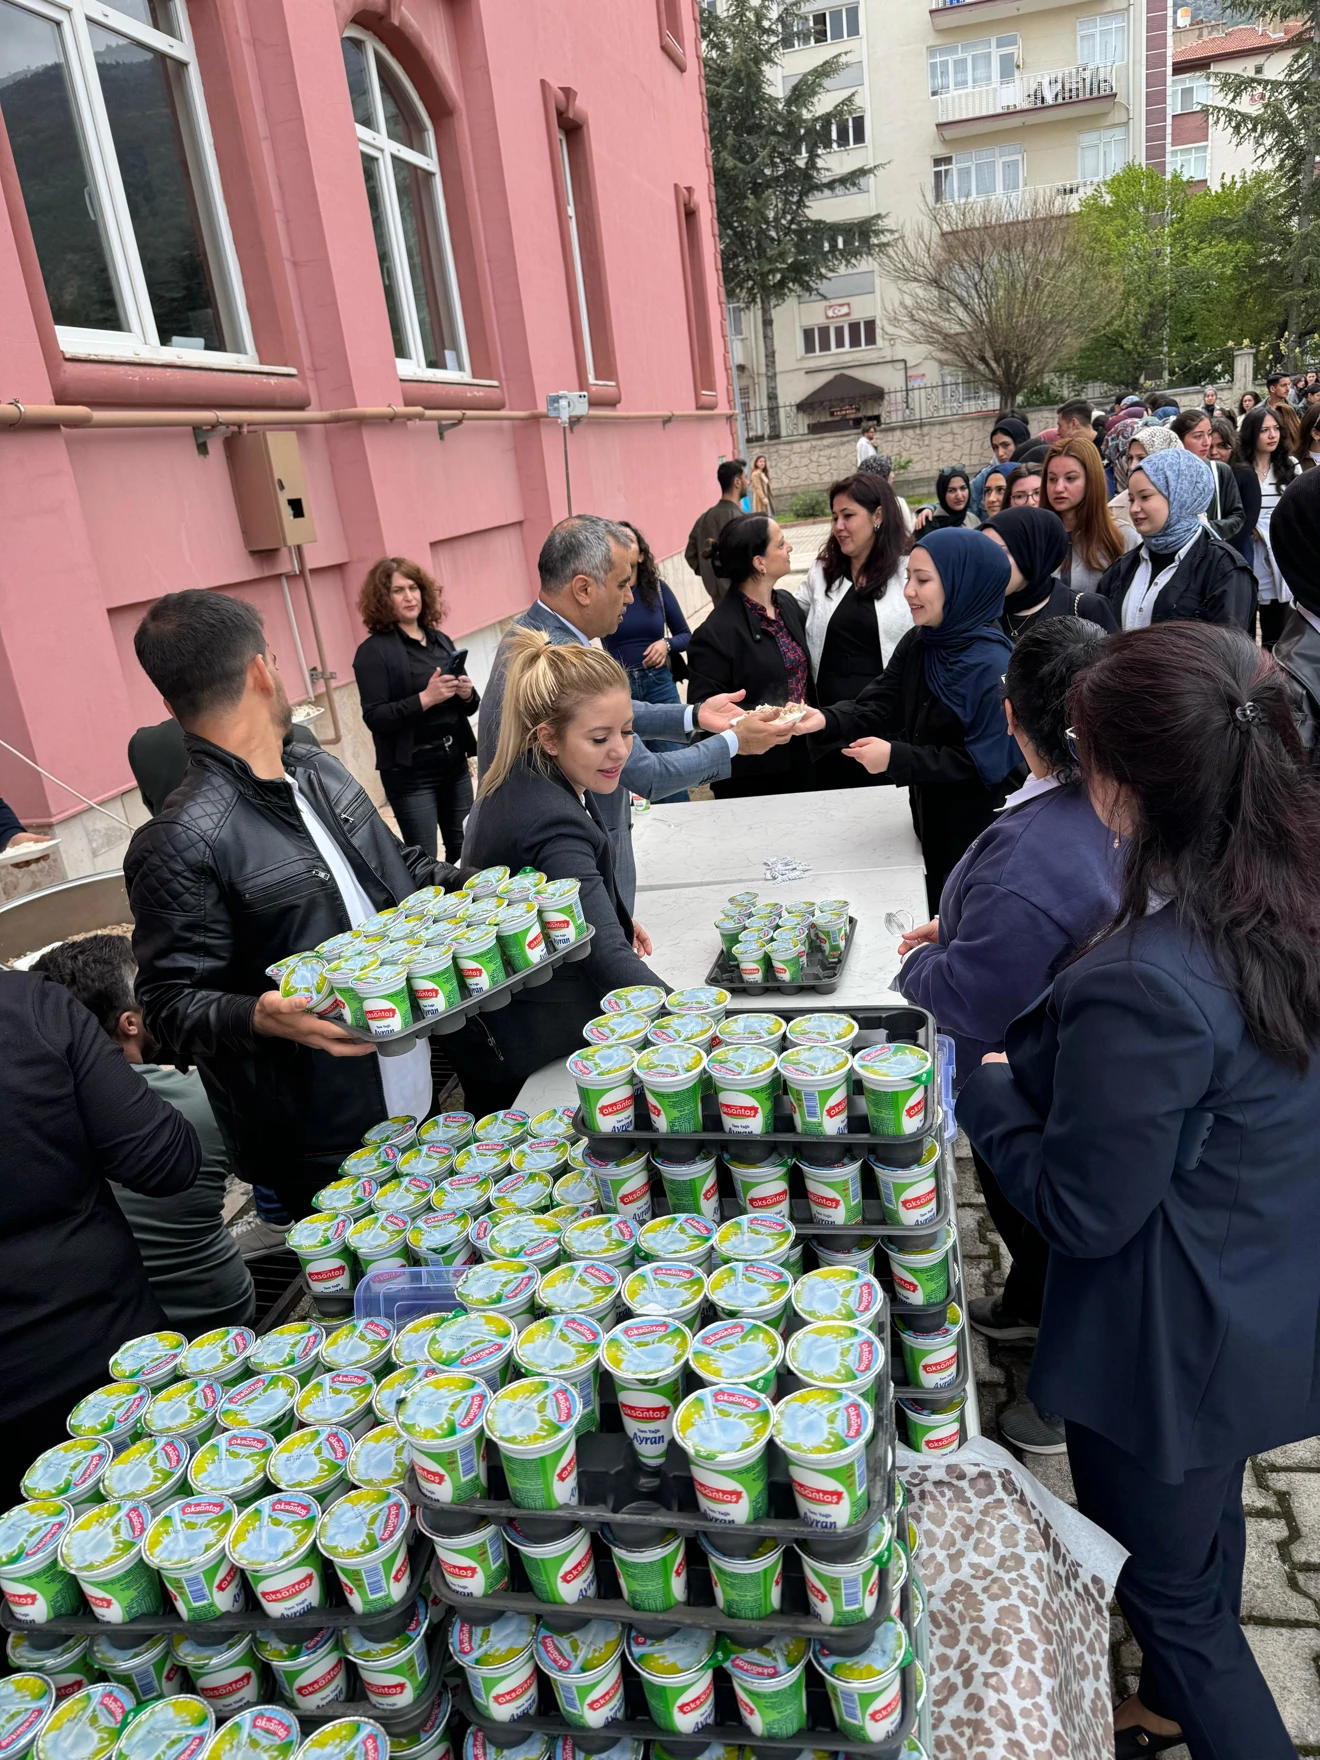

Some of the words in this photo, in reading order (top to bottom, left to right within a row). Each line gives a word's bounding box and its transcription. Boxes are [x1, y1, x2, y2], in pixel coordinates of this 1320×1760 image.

[233, 1381, 264, 1403] aksantaş
[717, 1394, 757, 1408] aksantaş
[622, 1407, 666, 1418] aksantaş
[231, 1438, 264, 1448] aksantaş
[633, 1432, 664, 1445] Ayran
[184, 1504, 221, 1514] aksantaş
[275, 1503, 307, 1516] aksantaş
[704, 1509, 735, 1524] Ayran
[381, 1506, 397, 1540] aksantaş
[803, 1512, 836, 1529] Ayran
[265, 1579, 310, 1600] aksantaş
[545, 1637, 568, 1667] aksantaş
[735, 1658, 774, 1675] aksantaş
[204, 1678, 247, 1696] aksantaş
[255, 1718, 288, 1738] aksantaş
